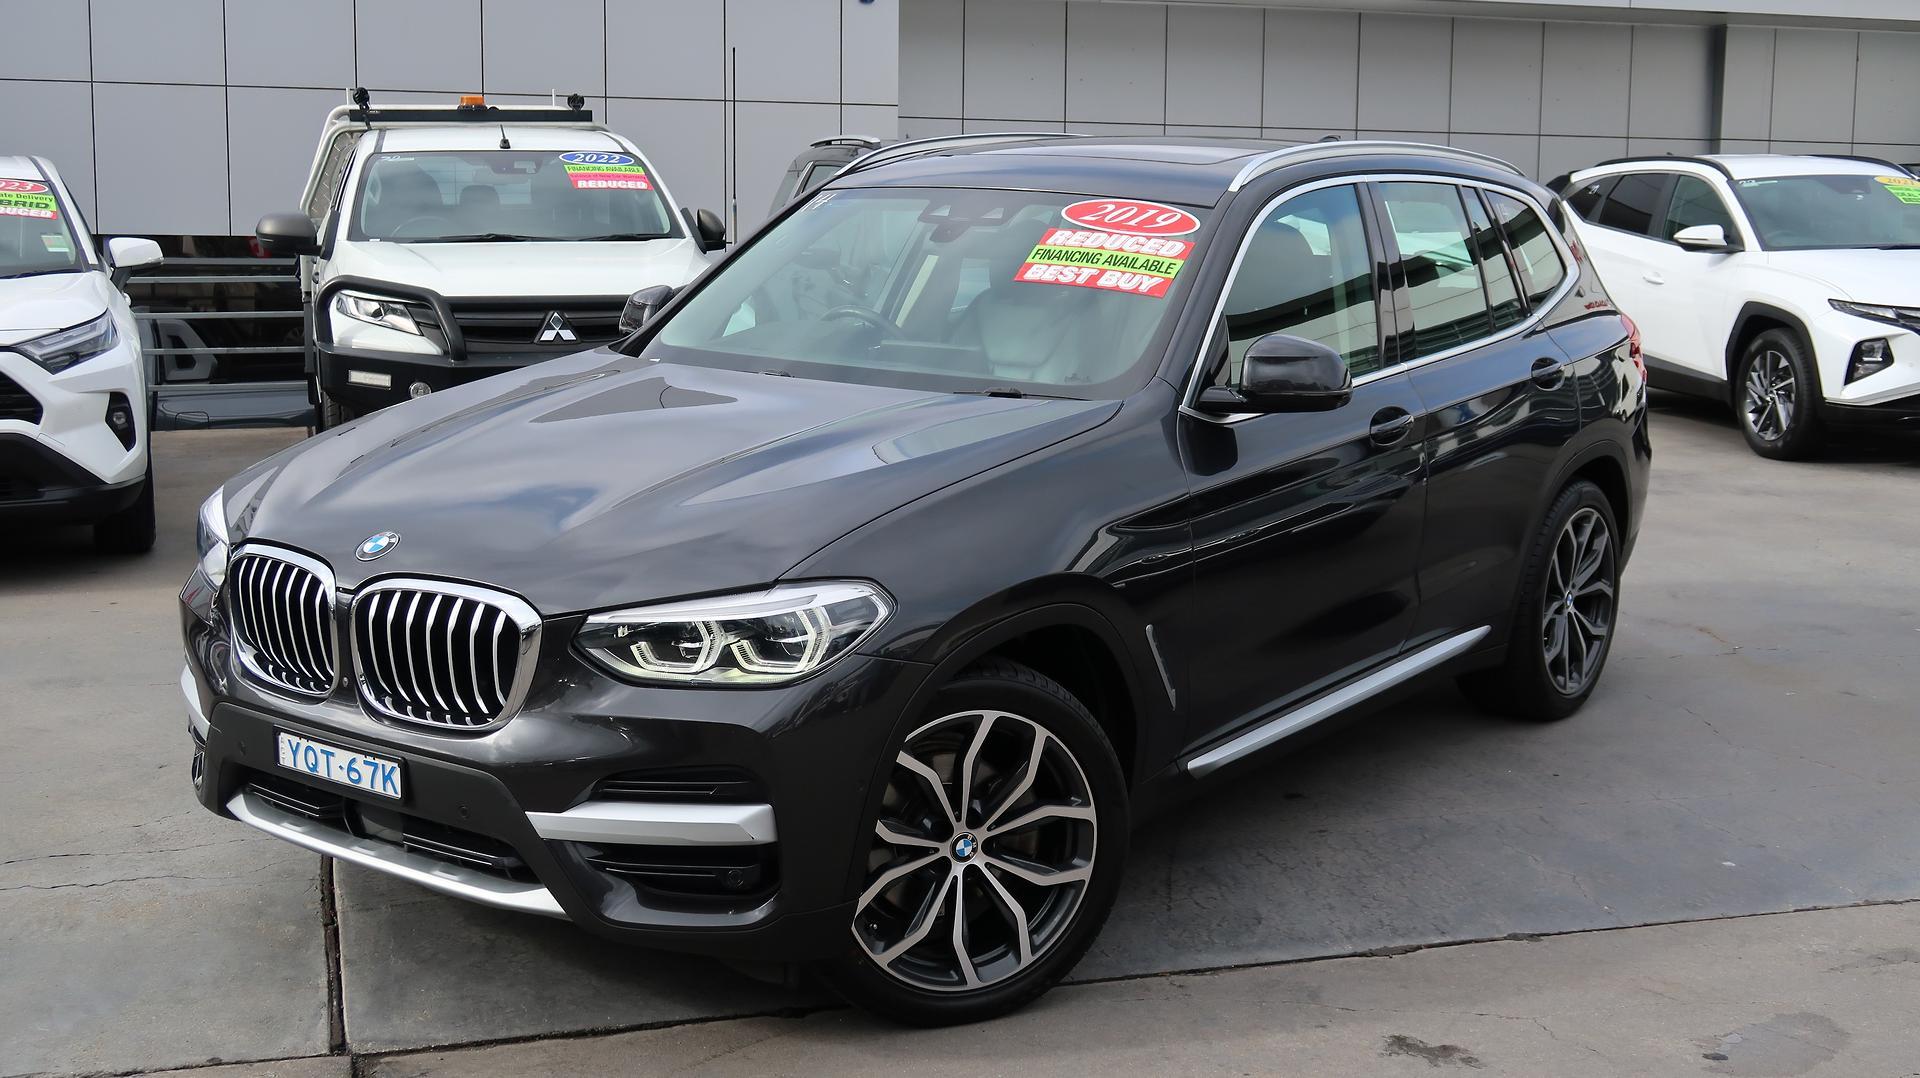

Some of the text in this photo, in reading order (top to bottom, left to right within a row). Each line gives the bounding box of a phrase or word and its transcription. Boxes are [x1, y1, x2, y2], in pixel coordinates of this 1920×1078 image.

[574, 153, 620, 163] 2022
[577, 180, 648, 189] REDUCED
[1079, 203, 1182, 228] 2019
[1046, 230, 1186, 257] REDUCED
[1032, 248, 1177, 275] FINANCING AVAILABLE
[1023, 264, 1164, 293] BEST BUY
